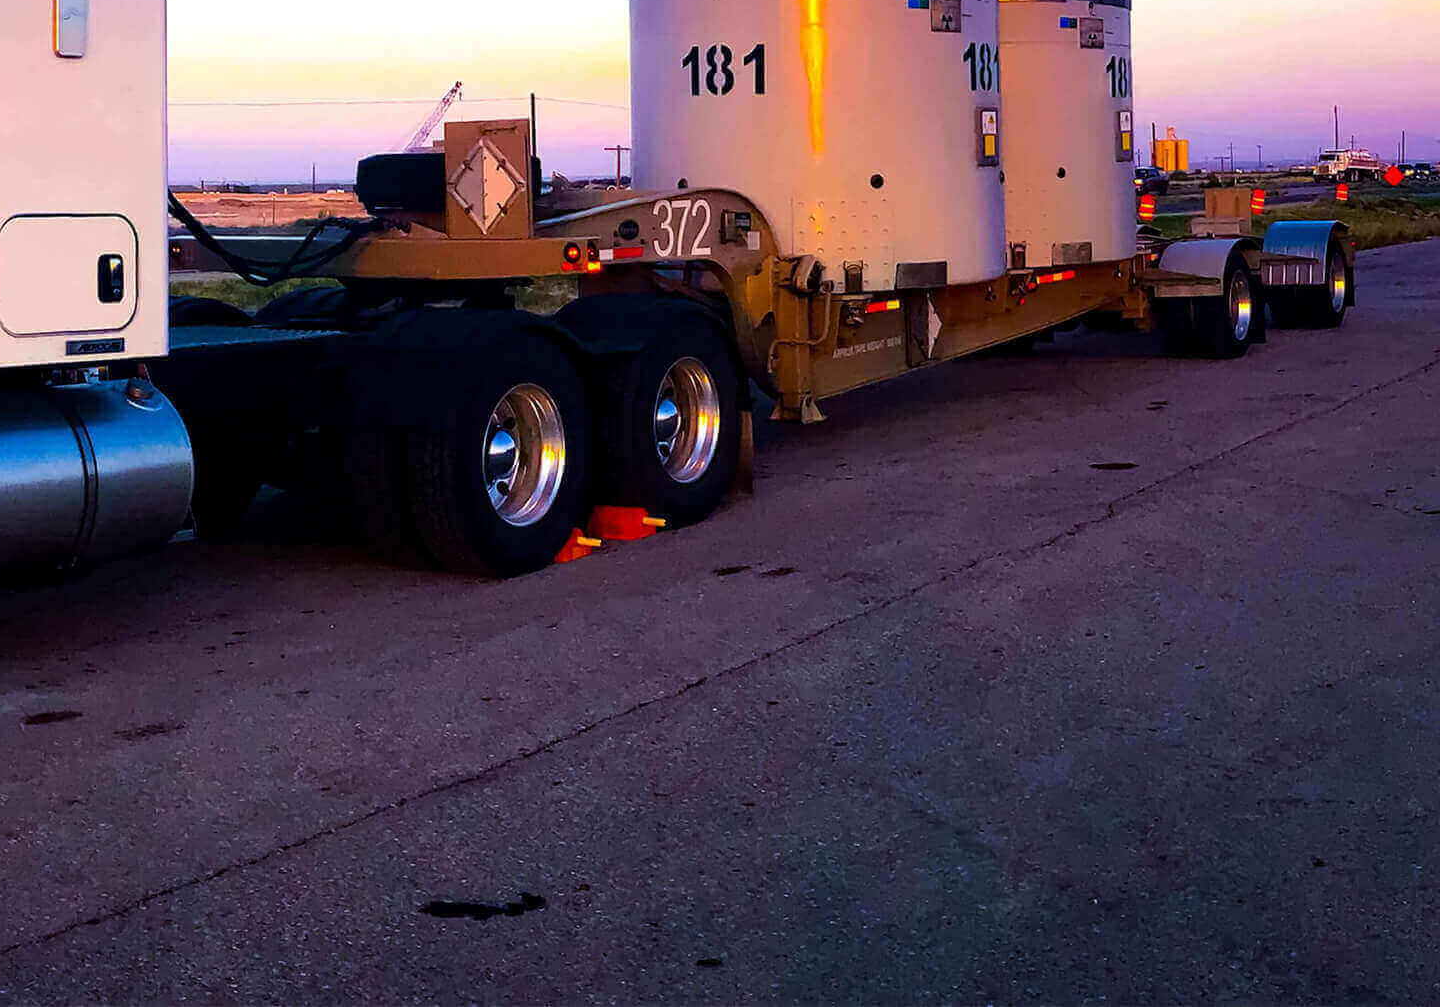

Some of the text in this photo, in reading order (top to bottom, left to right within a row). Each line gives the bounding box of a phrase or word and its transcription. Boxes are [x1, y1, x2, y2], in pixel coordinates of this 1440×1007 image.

[682, 43, 765, 96] 181
[1106, 55, 1132, 98] 18
[653, 199, 712, 258] 372
